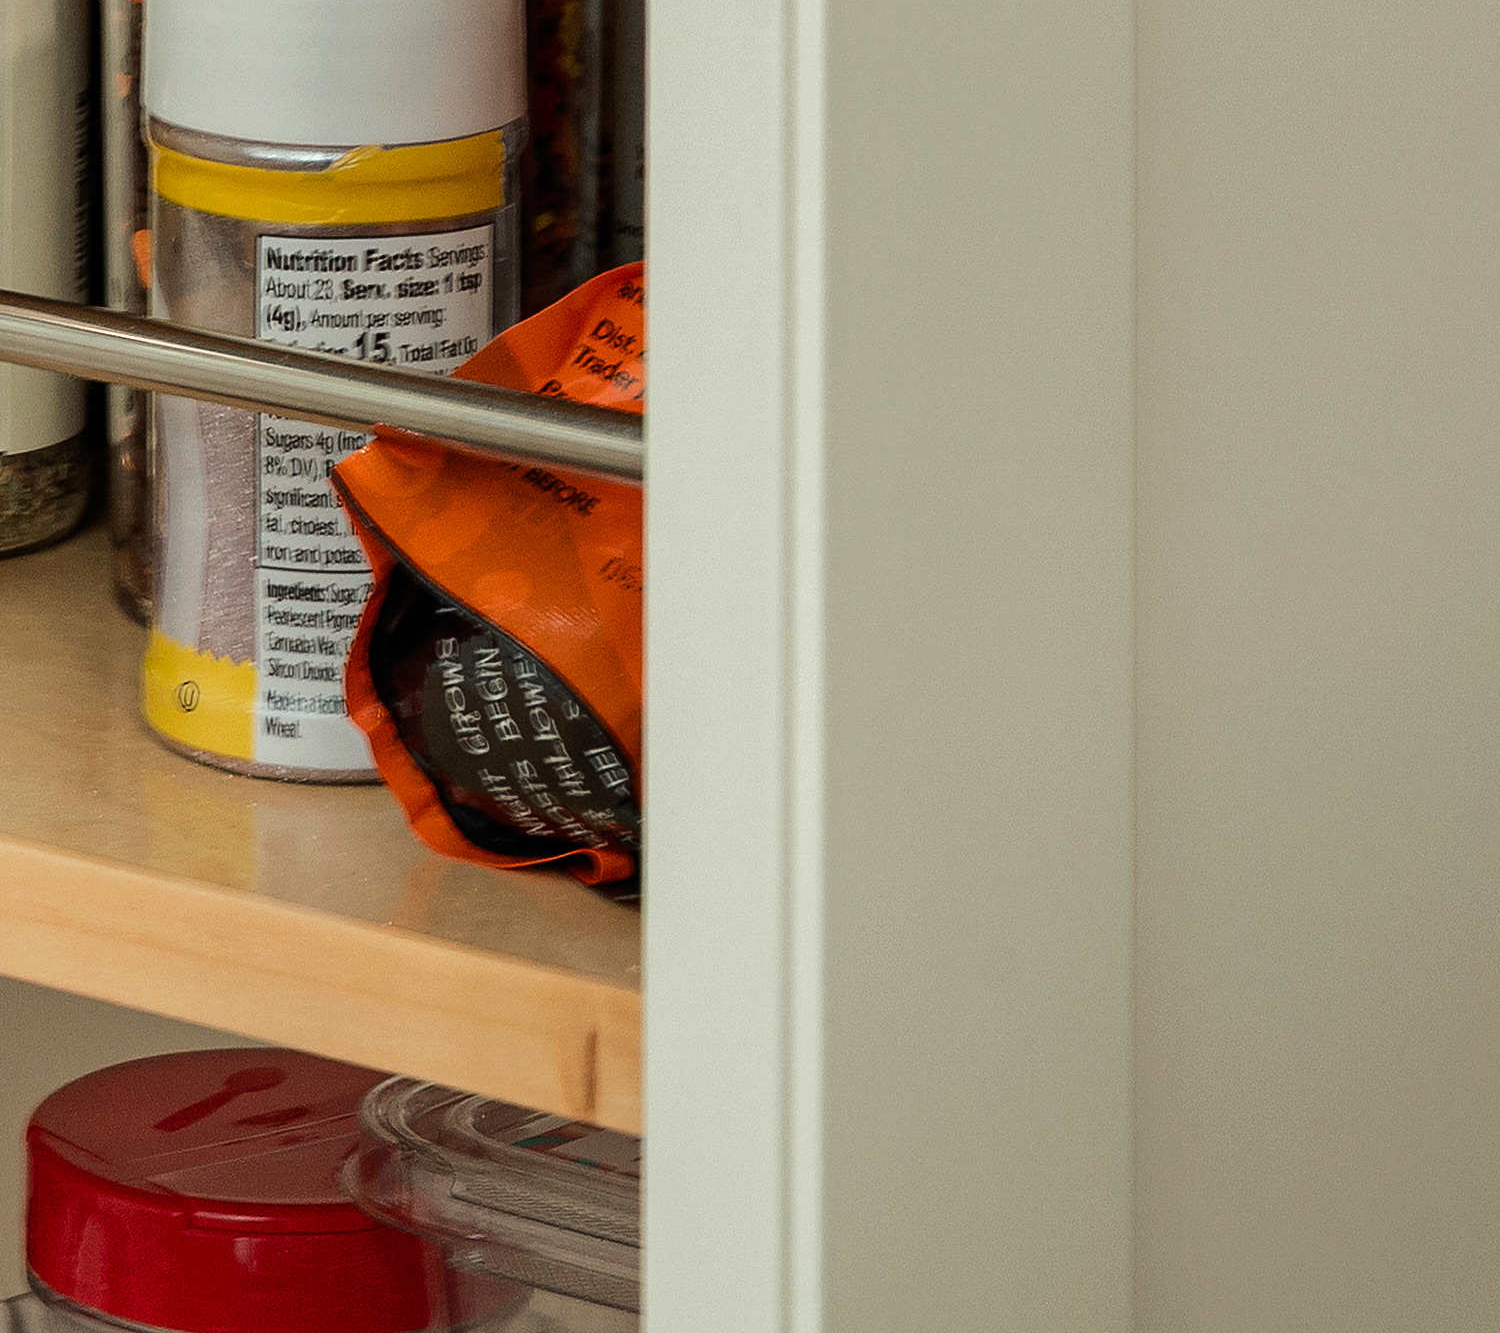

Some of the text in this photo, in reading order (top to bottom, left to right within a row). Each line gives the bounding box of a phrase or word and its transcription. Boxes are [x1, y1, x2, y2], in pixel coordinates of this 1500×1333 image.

[265, 245, 359, 273] Nutrition
[362, 246, 425, 272] Facts
[265, 269, 484, 301] About Serv. size: tsp
[310, 308, 364, 329] Amount
[394, 305, 448, 330] serving:
[591, 318, 636, 355] Dist.
[398, 339, 438, 363] Total
[265, 426, 315, 453] Sugars
[265, 485, 334, 511] significant
[265, 604, 325, 629] Pearlescent
[434, 636, 556, 837] NIGHT GROWS
[513, 650, 592, 798] HALLOWE
[473, 646, 609, 849] HOSTS BEGIN
